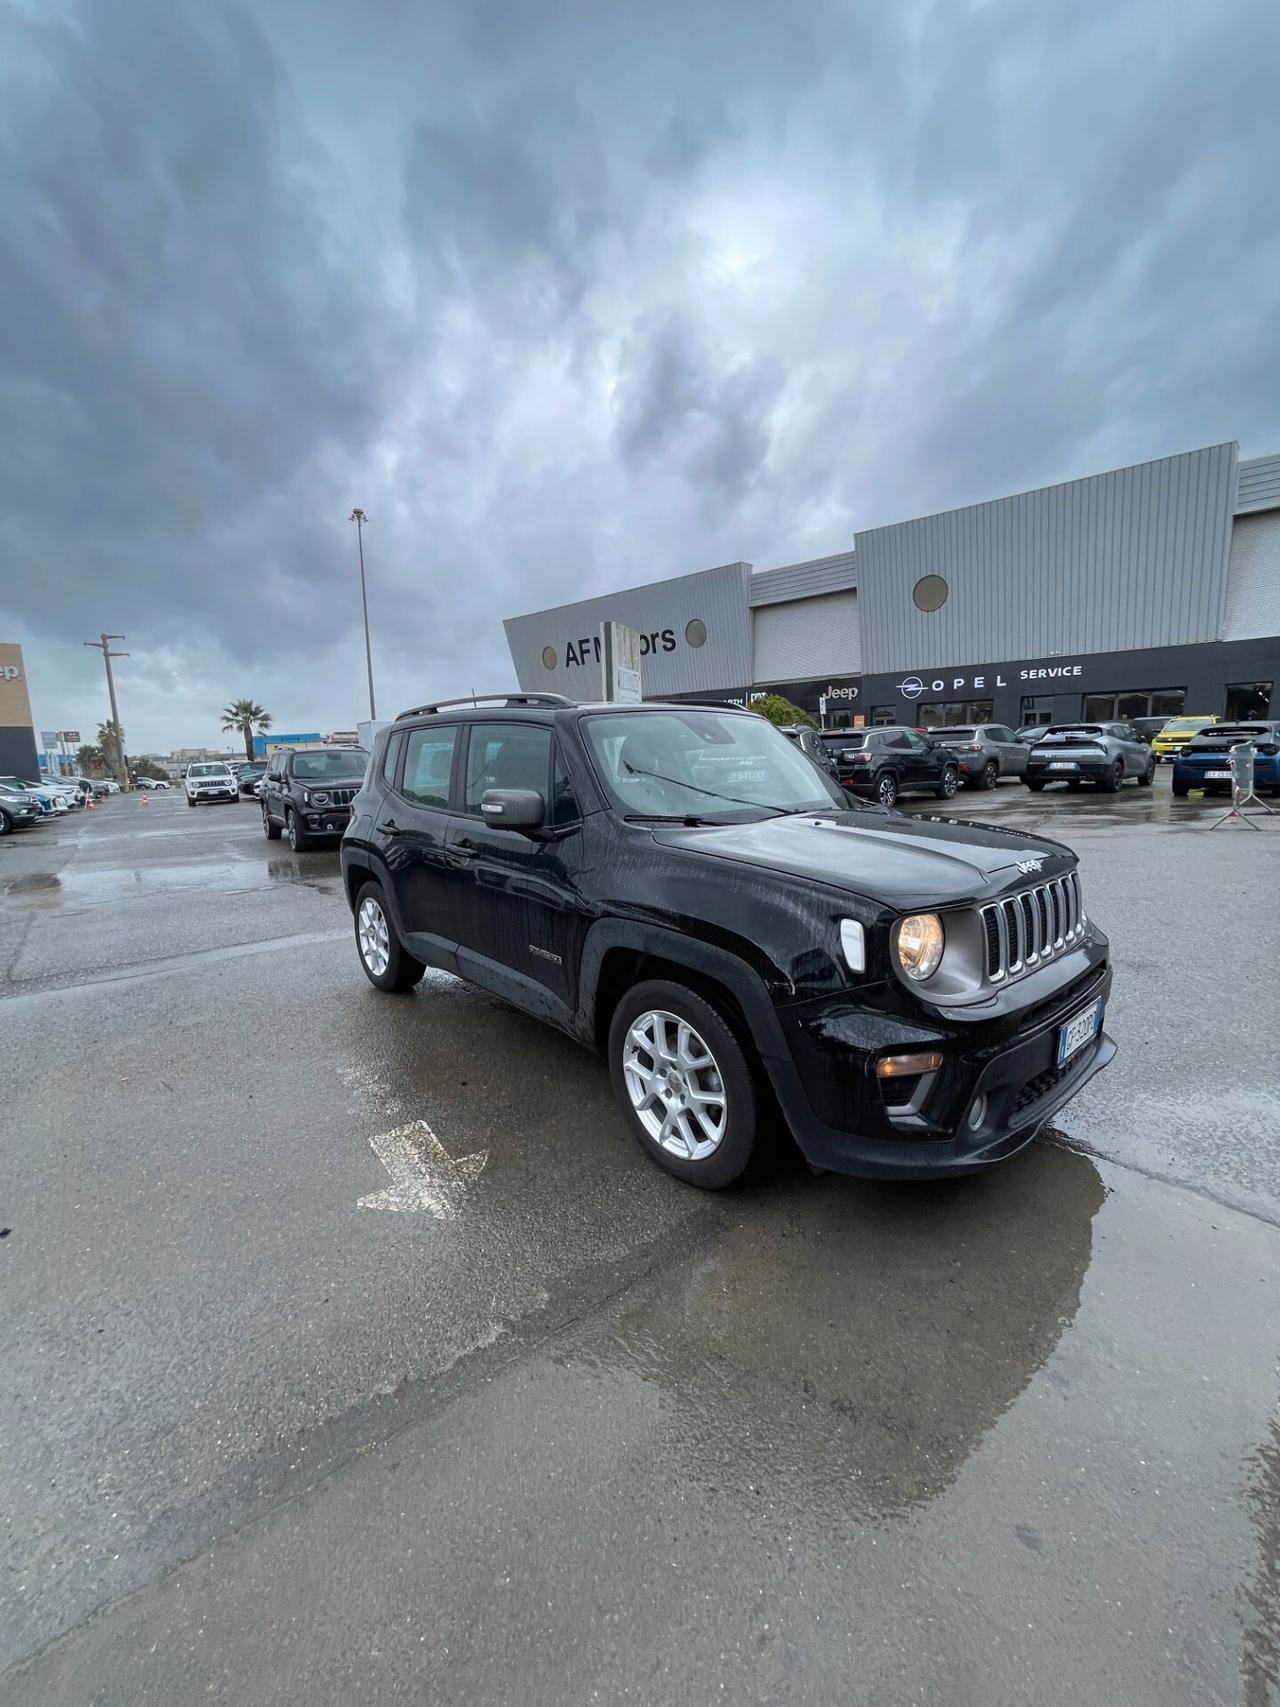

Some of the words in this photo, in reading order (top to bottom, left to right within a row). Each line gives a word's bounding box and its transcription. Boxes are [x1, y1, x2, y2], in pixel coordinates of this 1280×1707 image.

[565, 629, 677, 668] AFors
[931, 676, 1007, 691] OPEL
[1020, 666, 1083, 680] SERVICE
[822, 685, 859, 700] Jeep
